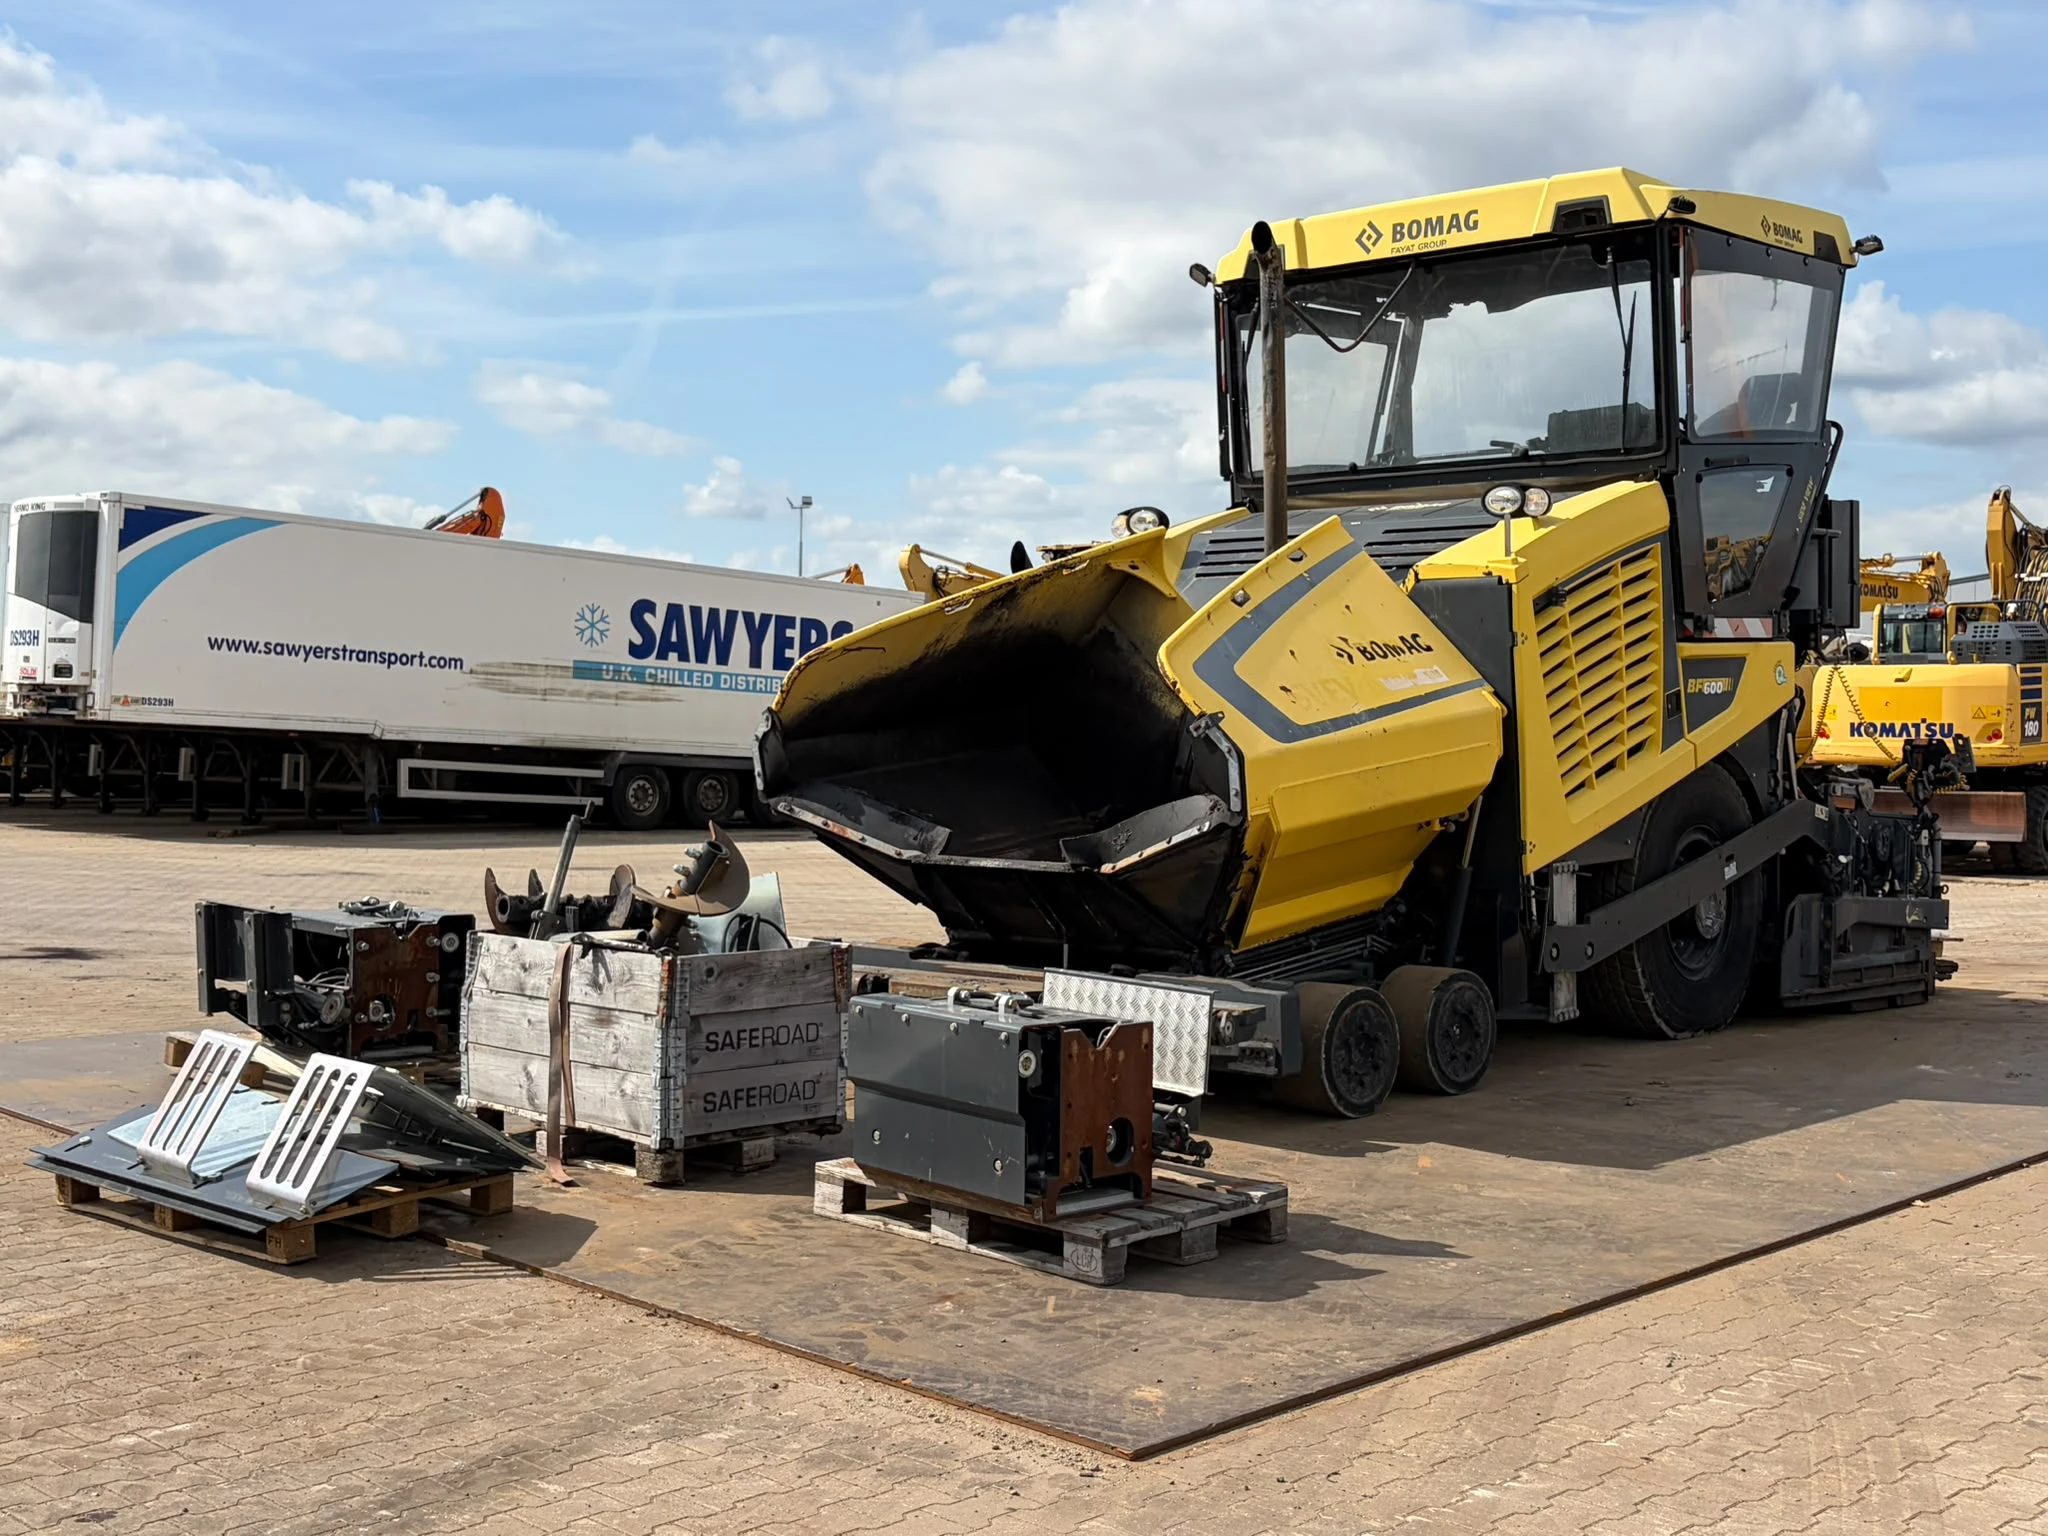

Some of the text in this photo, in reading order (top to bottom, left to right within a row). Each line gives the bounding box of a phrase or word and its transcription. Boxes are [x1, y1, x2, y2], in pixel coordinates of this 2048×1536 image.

[1391, 209, 1479, 243] BOMAG
[1773, 222, 1803, 243] BOMAG
[1391, 239, 1447, 255] FAYAT GROUP
[31, 502, 46, 511] KING
[10, 629, 40, 647] DS293H
[628, 598, 854, 671] SAWYER
[207, 636, 464, 671] www.sawyerstransport.com
[602, 665, 782, 692] U.K. CHILLED DISTRIB
[141, 696, 174, 707] DS293H
[2024, 706, 2037, 720] PW
[1850, 718, 1954, 739] KOMATSU
[2024, 720, 2039, 737] 180
[705, 1022, 819, 1053] SAFEROAD
[703, 1079, 816, 1114] SAFEROAD
